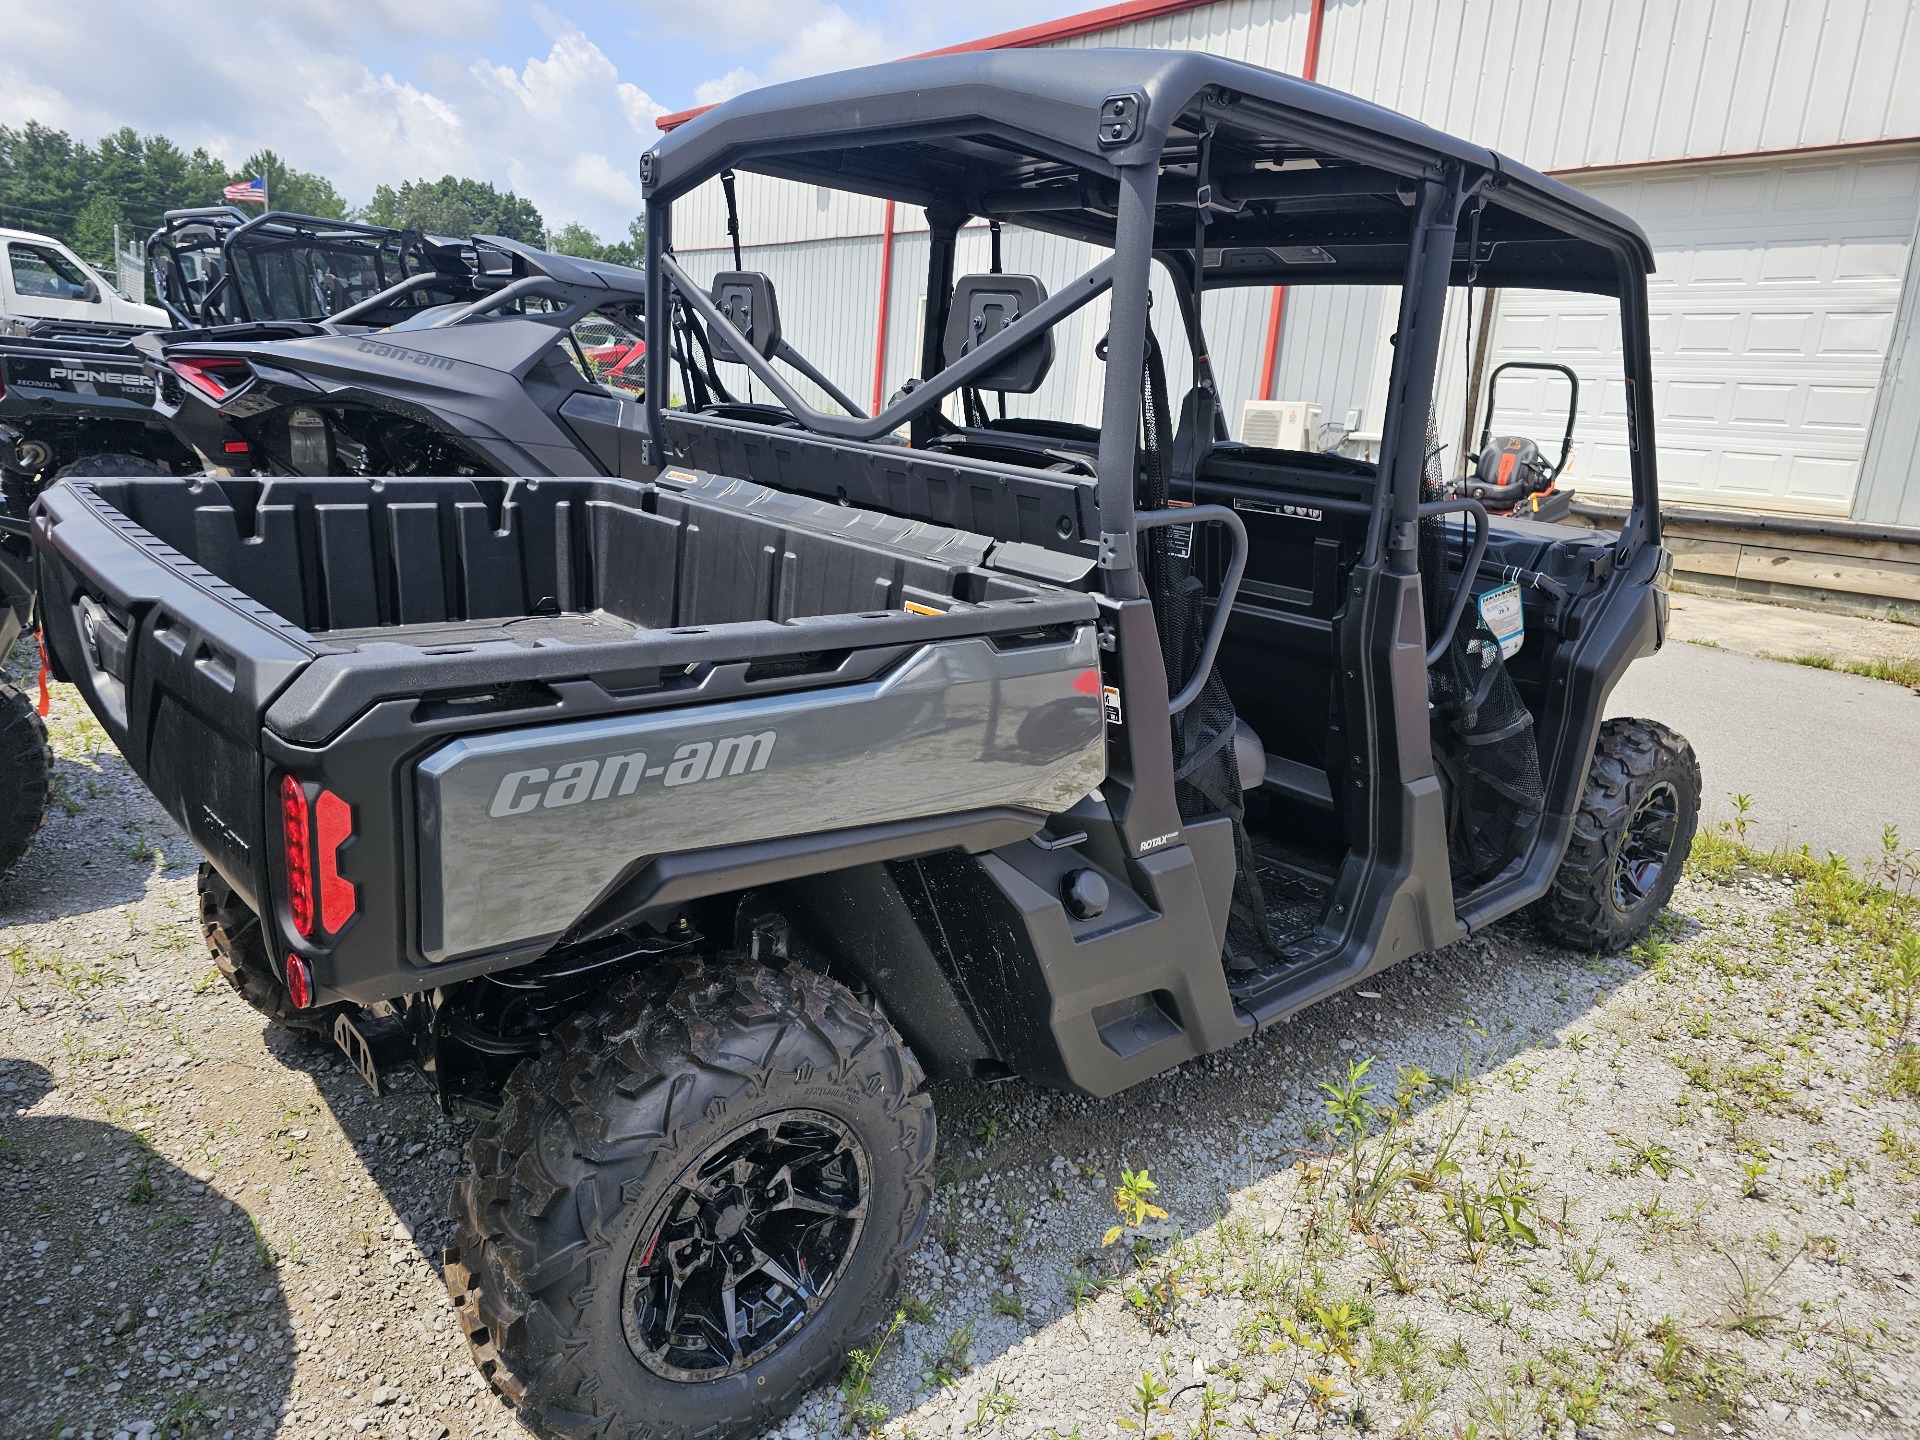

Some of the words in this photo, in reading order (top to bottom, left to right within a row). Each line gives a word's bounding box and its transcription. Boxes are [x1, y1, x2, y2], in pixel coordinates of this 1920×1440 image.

[357, 341, 456, 371] can-am
[16, 379, 61, 389] HONDA
[50, 367, 155, 387] PIONEER
[121, 386, 156, 395] 1000
[489, 730, 777, 818] can-am
[1140, 835, 1168, 851] ROTAX
